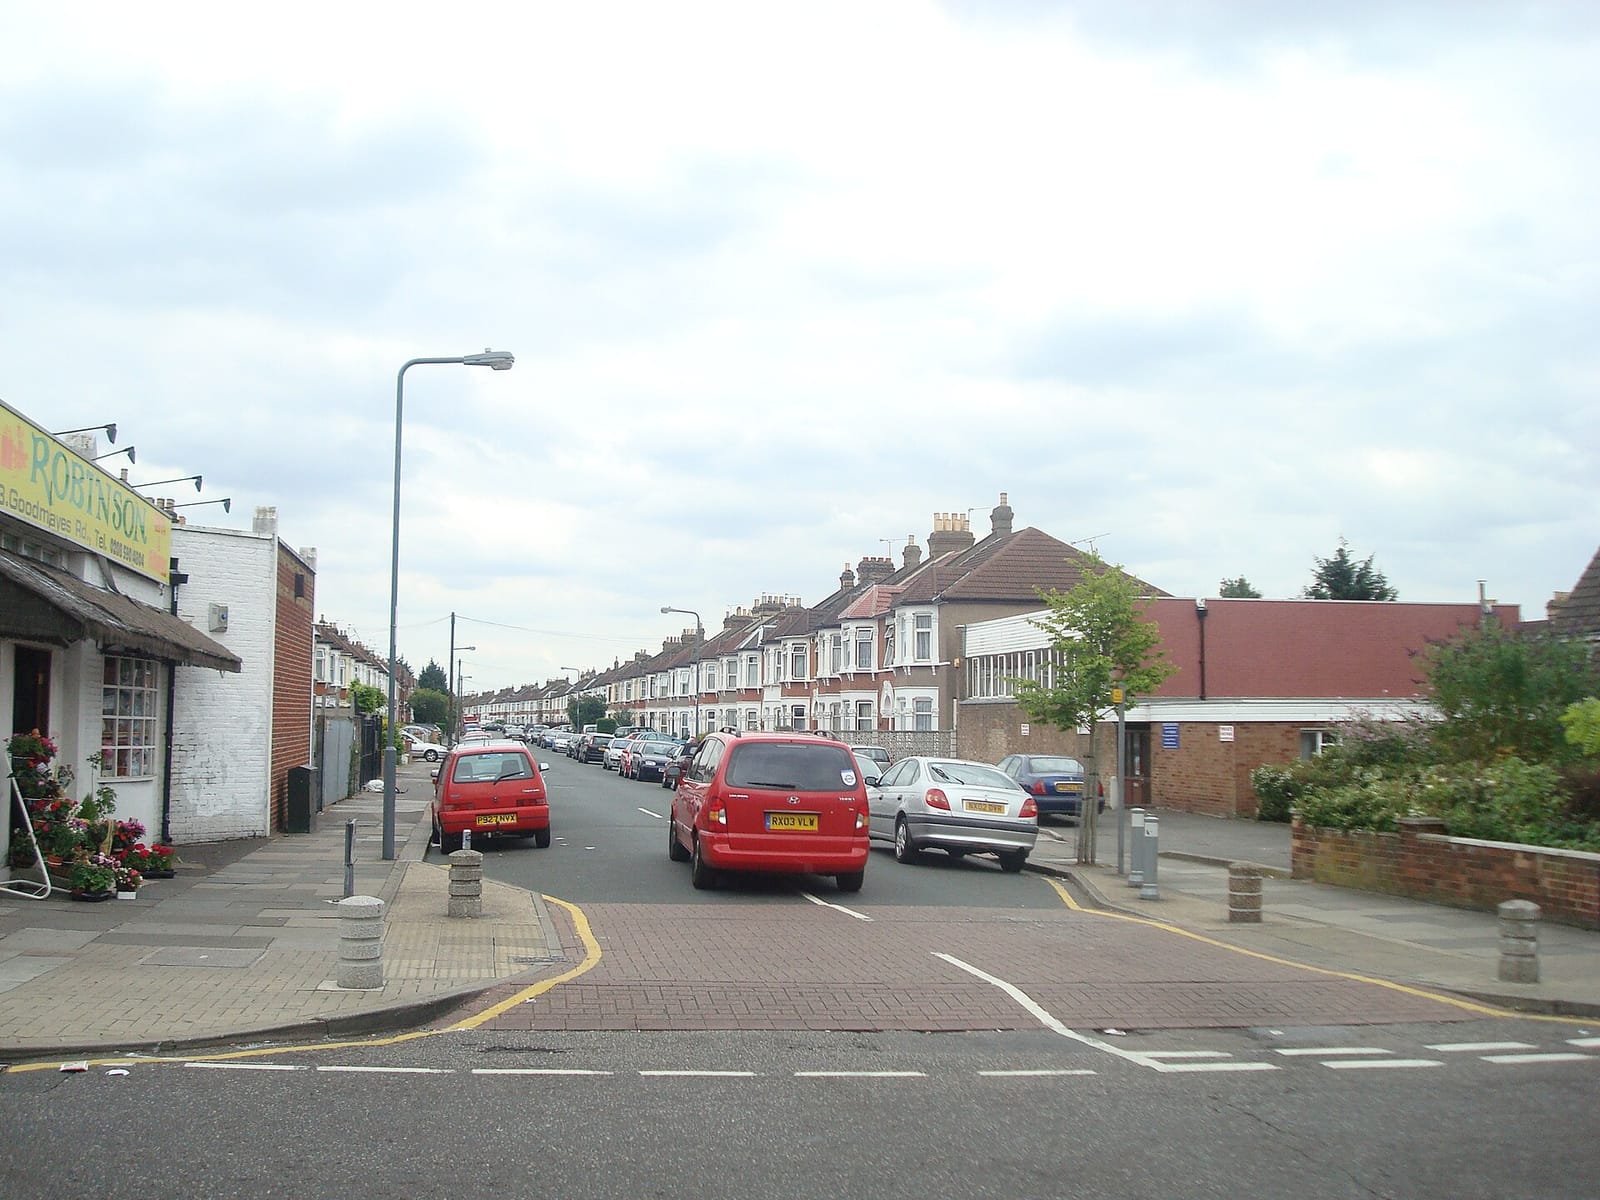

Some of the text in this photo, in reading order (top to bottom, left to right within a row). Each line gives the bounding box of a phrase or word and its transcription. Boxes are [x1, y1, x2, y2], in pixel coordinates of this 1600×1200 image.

[31, 432, 147, 545] ROBINSON
[477, 814, 515, 825] P927 NVX
[771, 816, 795, 826] RX03
